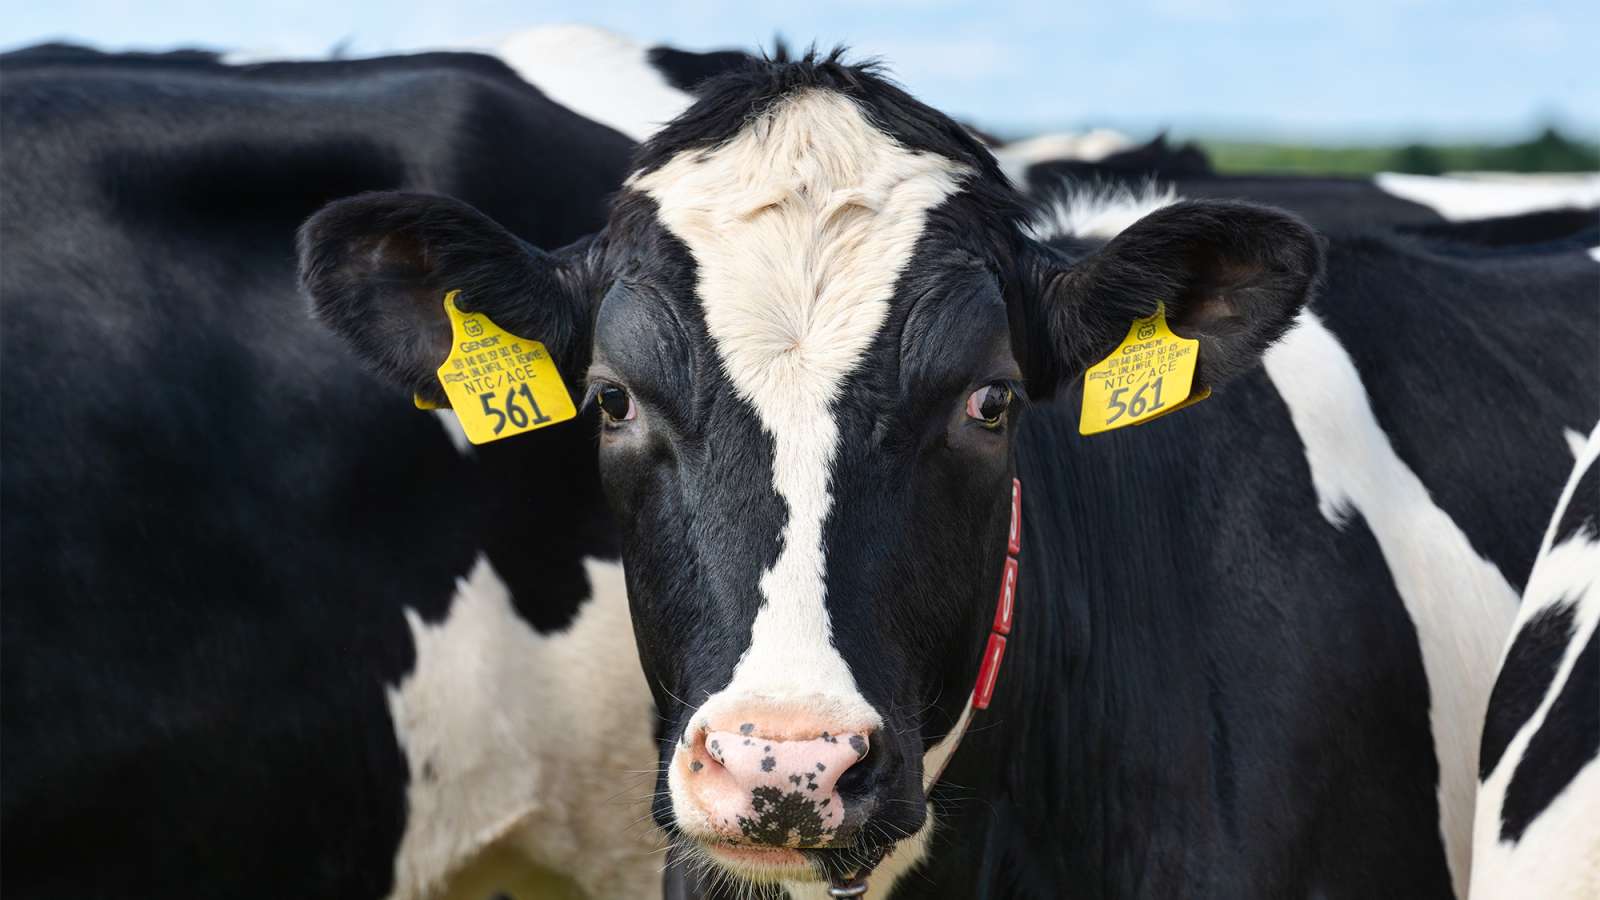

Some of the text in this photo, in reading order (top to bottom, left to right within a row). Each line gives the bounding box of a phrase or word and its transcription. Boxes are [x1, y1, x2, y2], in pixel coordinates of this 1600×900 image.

[463, 364, 537, 395] NTC/ACE
[1104, 360, 1177, 390] NTC/ACE
[480, 382, 552, 435] 561
[1106, 376, 1165, 425] 561
